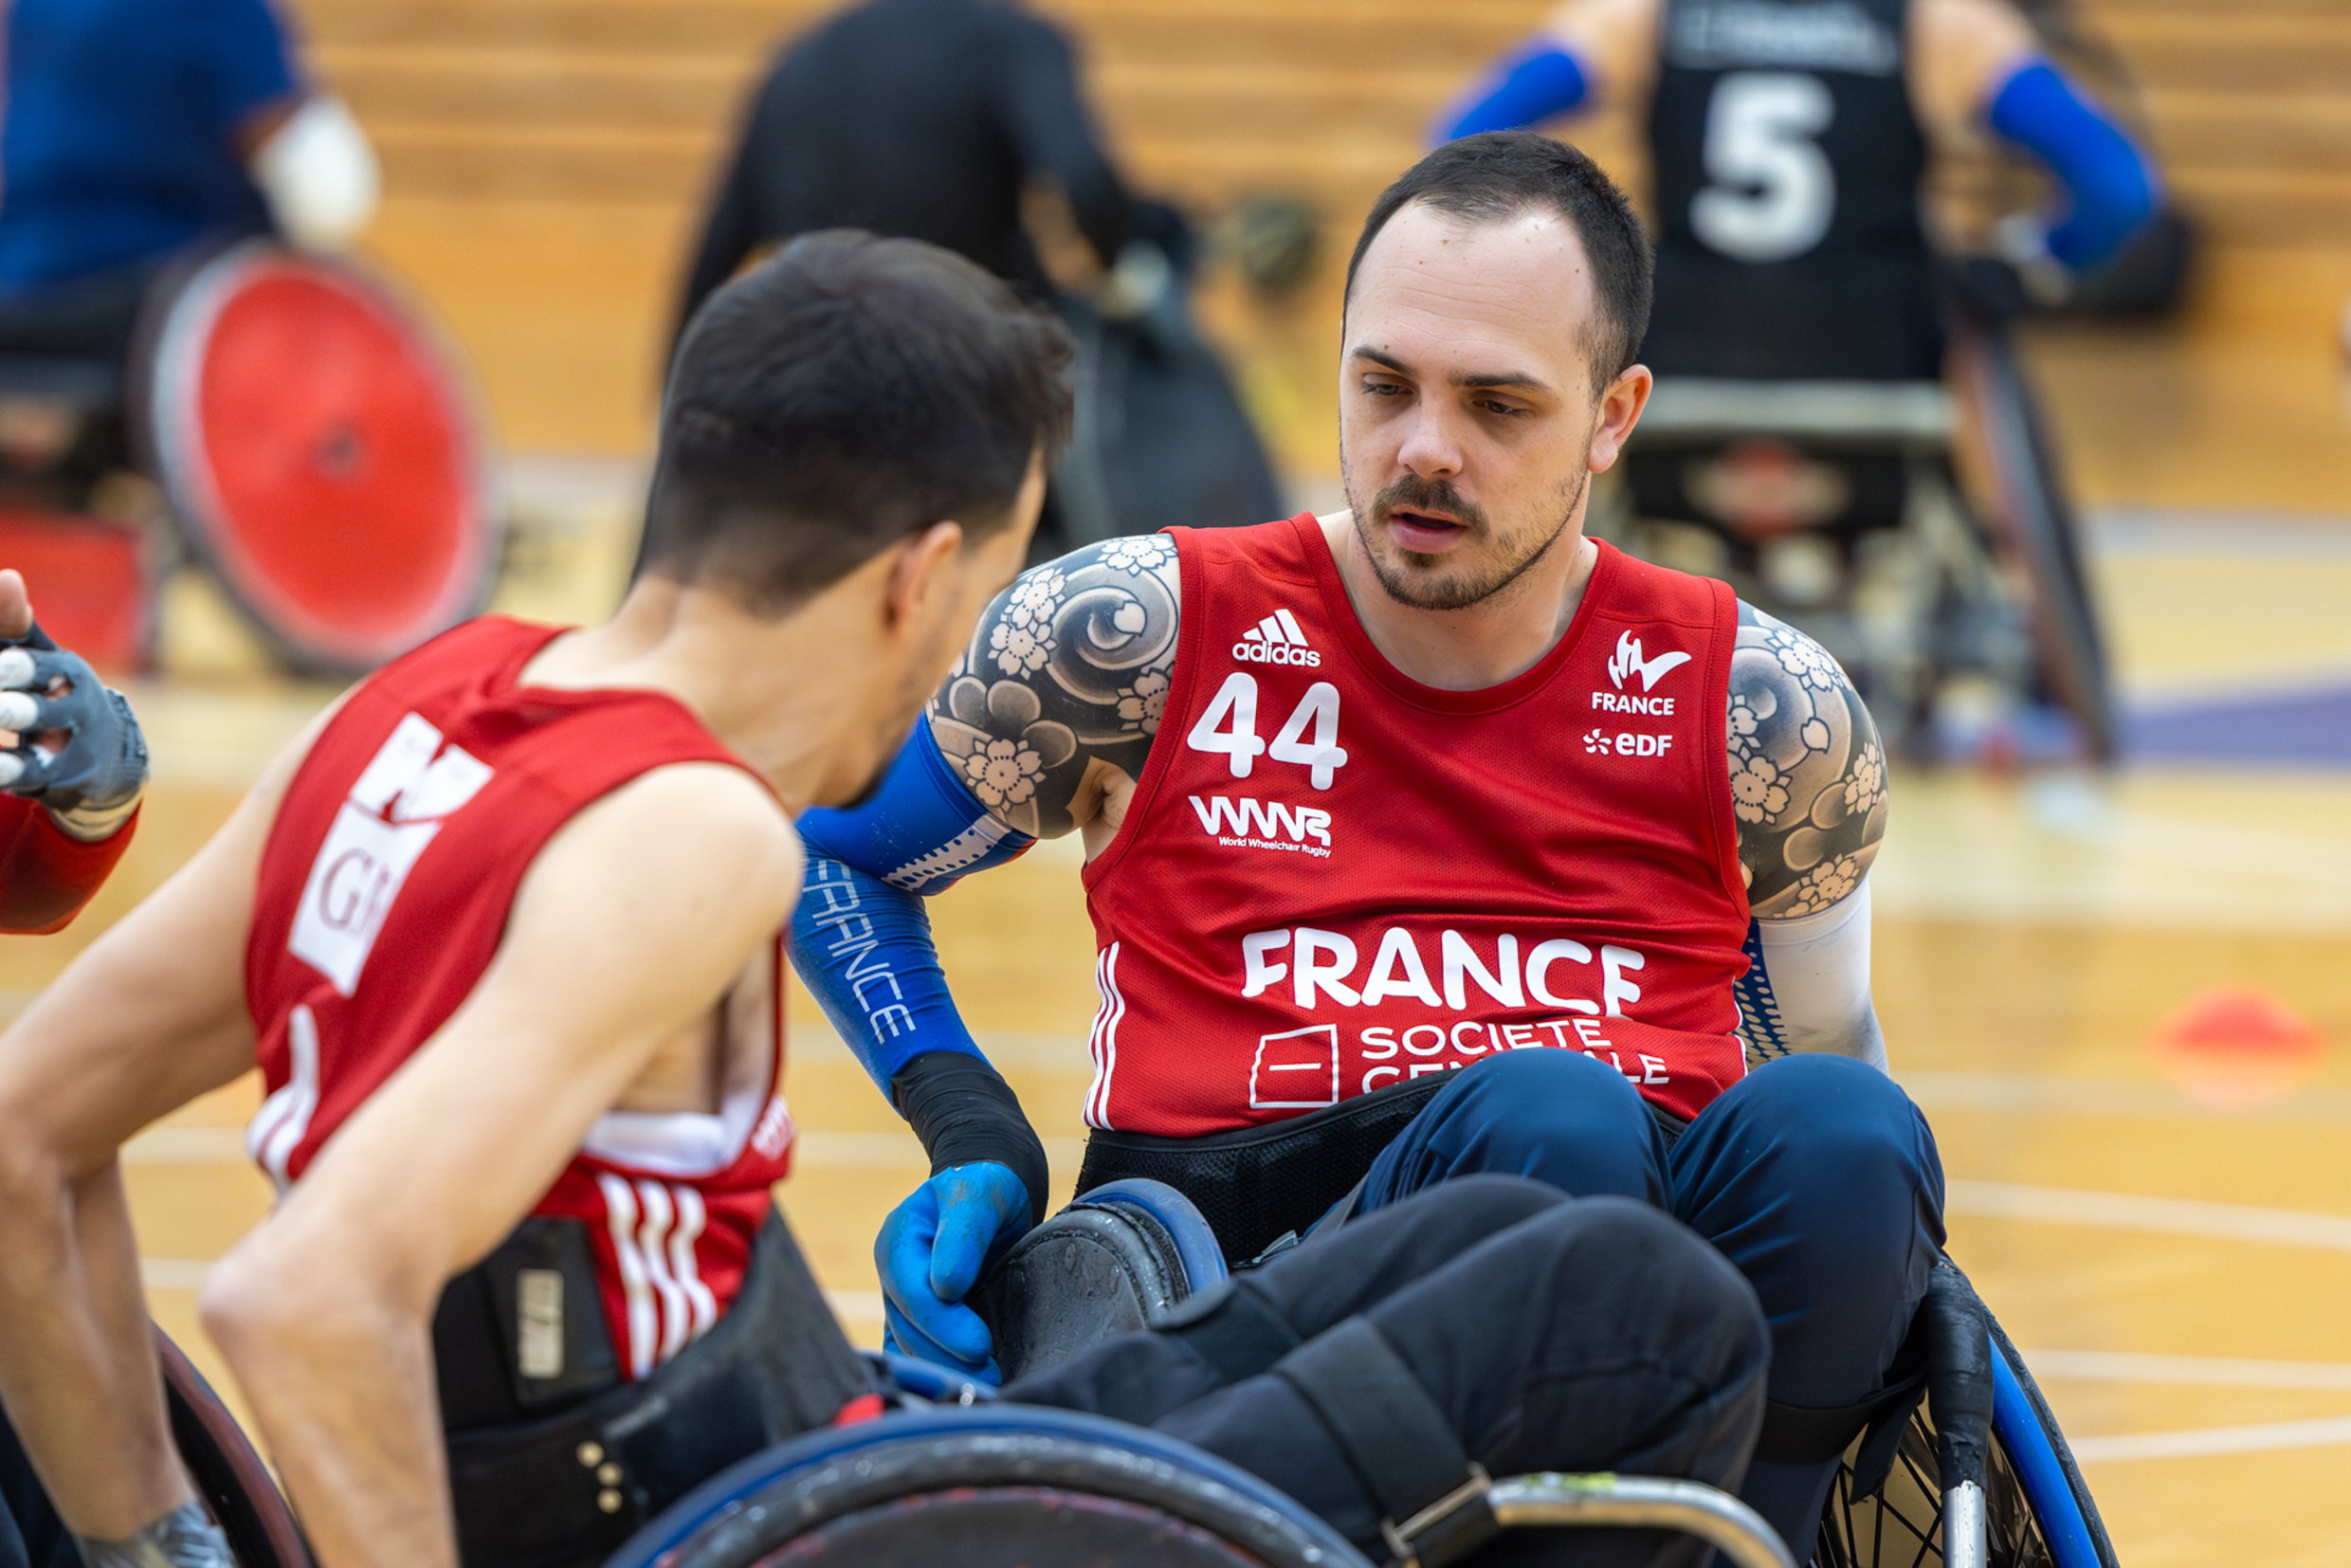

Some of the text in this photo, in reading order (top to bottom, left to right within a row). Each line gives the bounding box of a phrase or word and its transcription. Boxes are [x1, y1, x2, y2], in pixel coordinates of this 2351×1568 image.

[1687, 68, 1835, 263] 5
[1232, 640, 1321, 667] adidas
[1591, 691, 1675, 716] FRANCE
[1187, 671, 1348, 791] 44
[1218, 836, 1332, 859] World Wheelchair Rugby
[1240, 926, 1646, 1020] FRANCE
[1359, 1018, 1613, 1060] SOCIETE
